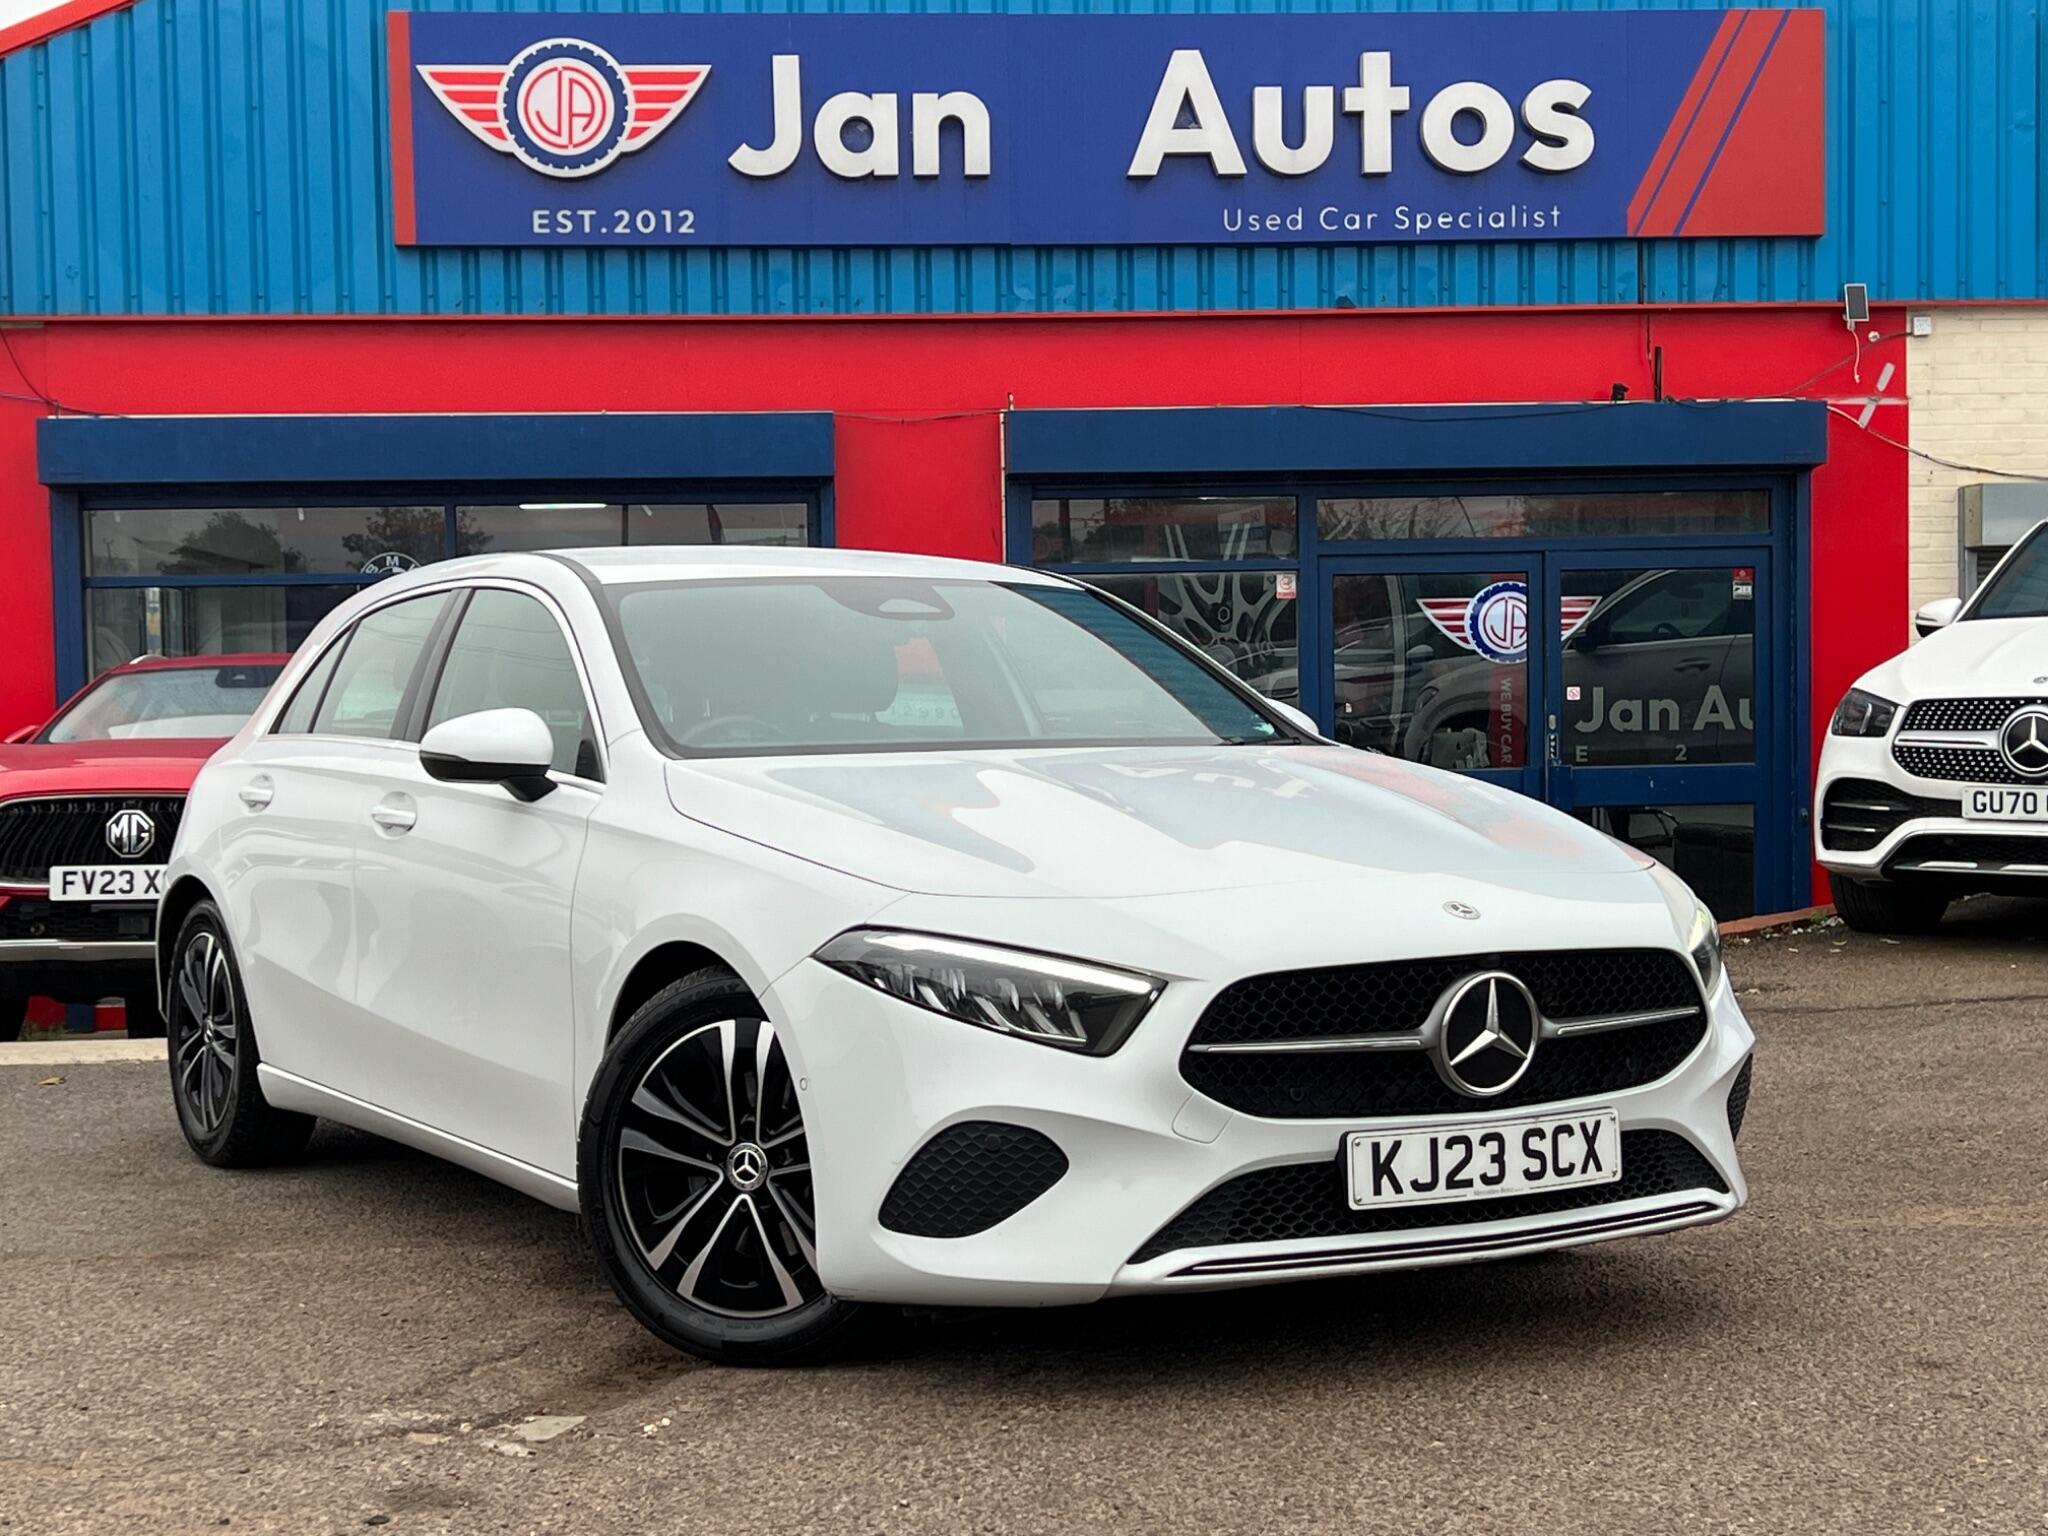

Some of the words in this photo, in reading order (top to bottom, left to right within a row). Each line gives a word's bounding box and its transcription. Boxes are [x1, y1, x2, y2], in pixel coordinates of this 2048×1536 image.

[728, 54, 991, 178] Jan
[1126, 49, 1596, 178] Autos
[532, 209, 695, 234] EST.2012
[1223, 206, 1303, 232] Used
[1319, 206, 1378, 231] Car
[1394, 204, 1561, 236] Specialist
[1500, 677, 1513, 701] WE
[1500, 703, 1513, 732] BUY
[1574, 686, 1680, 733] Jan
[1500, 734, 1513, 764] CAR
[1575, 745, 1589, 763] E
[1674, 744, 1688, 761] 2
[1973, 790, 2037, 815] GU70
[109, 813, 152, 854] MG
[61, 870, 135, 896] FV23
[144, 869, 160, 895] X
[1370, 1131, 1506, 1197] KJ23
[1521, 1119, 1603, 1182] SCX
